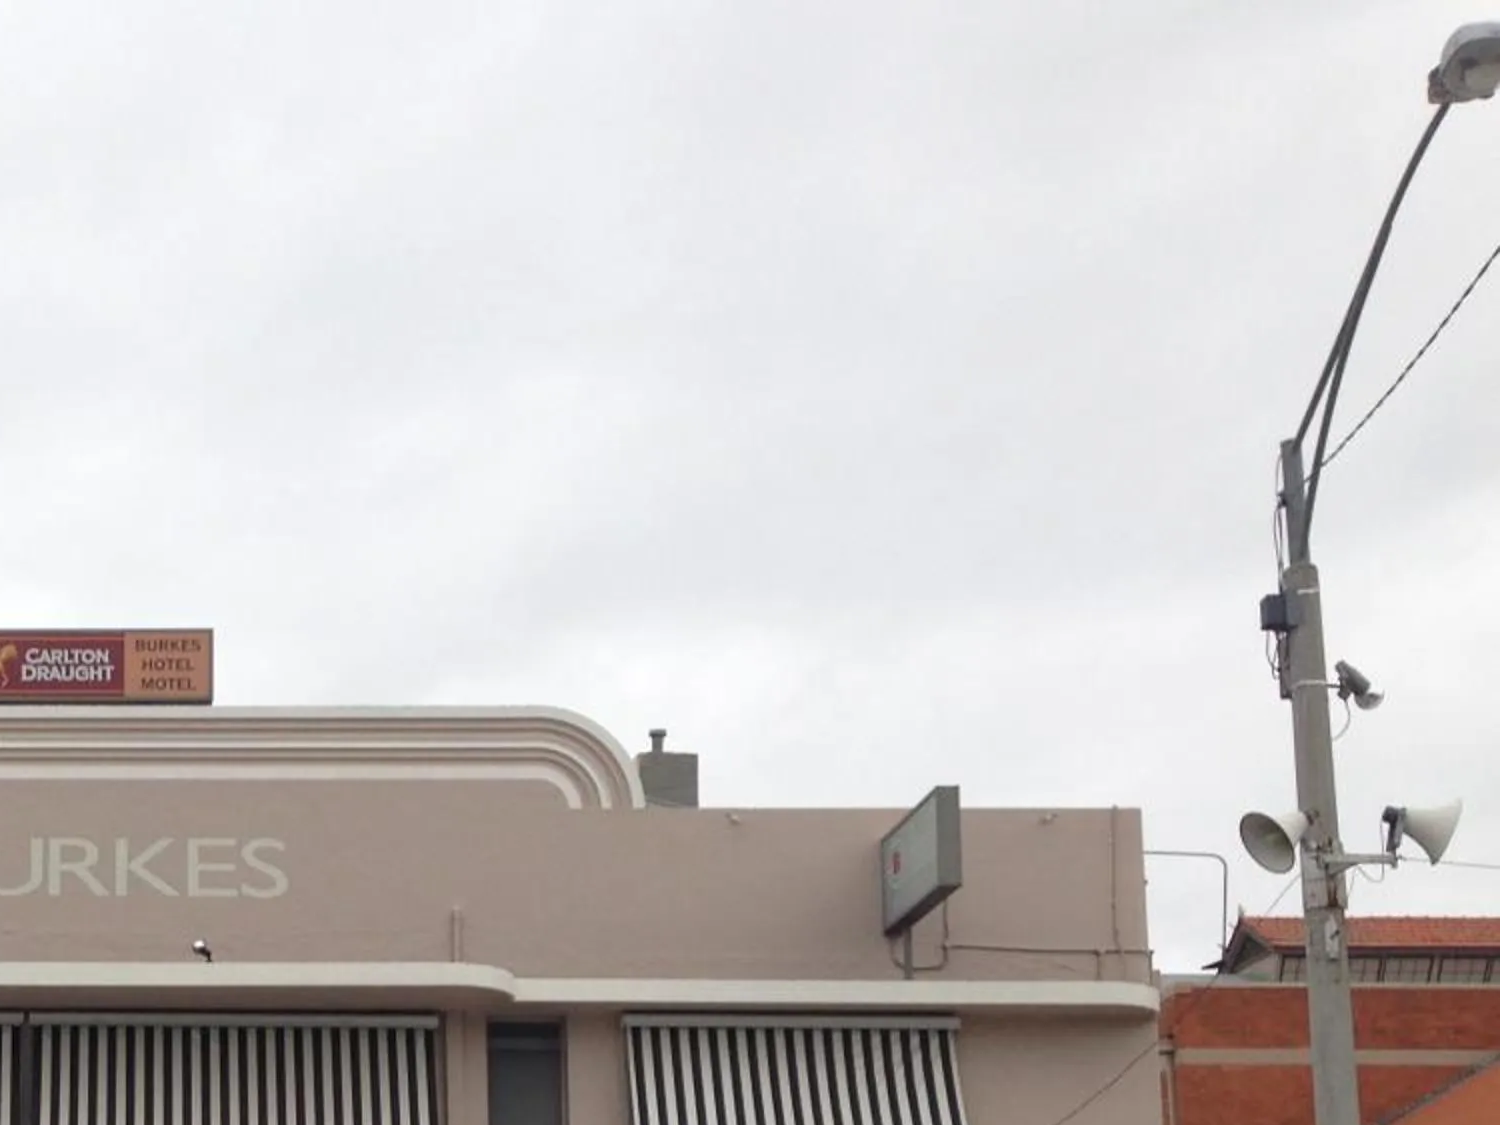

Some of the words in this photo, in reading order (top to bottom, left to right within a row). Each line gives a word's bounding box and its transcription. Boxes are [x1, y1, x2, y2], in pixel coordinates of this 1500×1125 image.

[135, 638, 201, 652] BURKES
[25, 648, 109, 664] CARLTON
[142, 658, 194, 671] HOTEL
[21, 664, 114, 682] DRAUGHT
[141, 677, 196, 691] MOTEL
